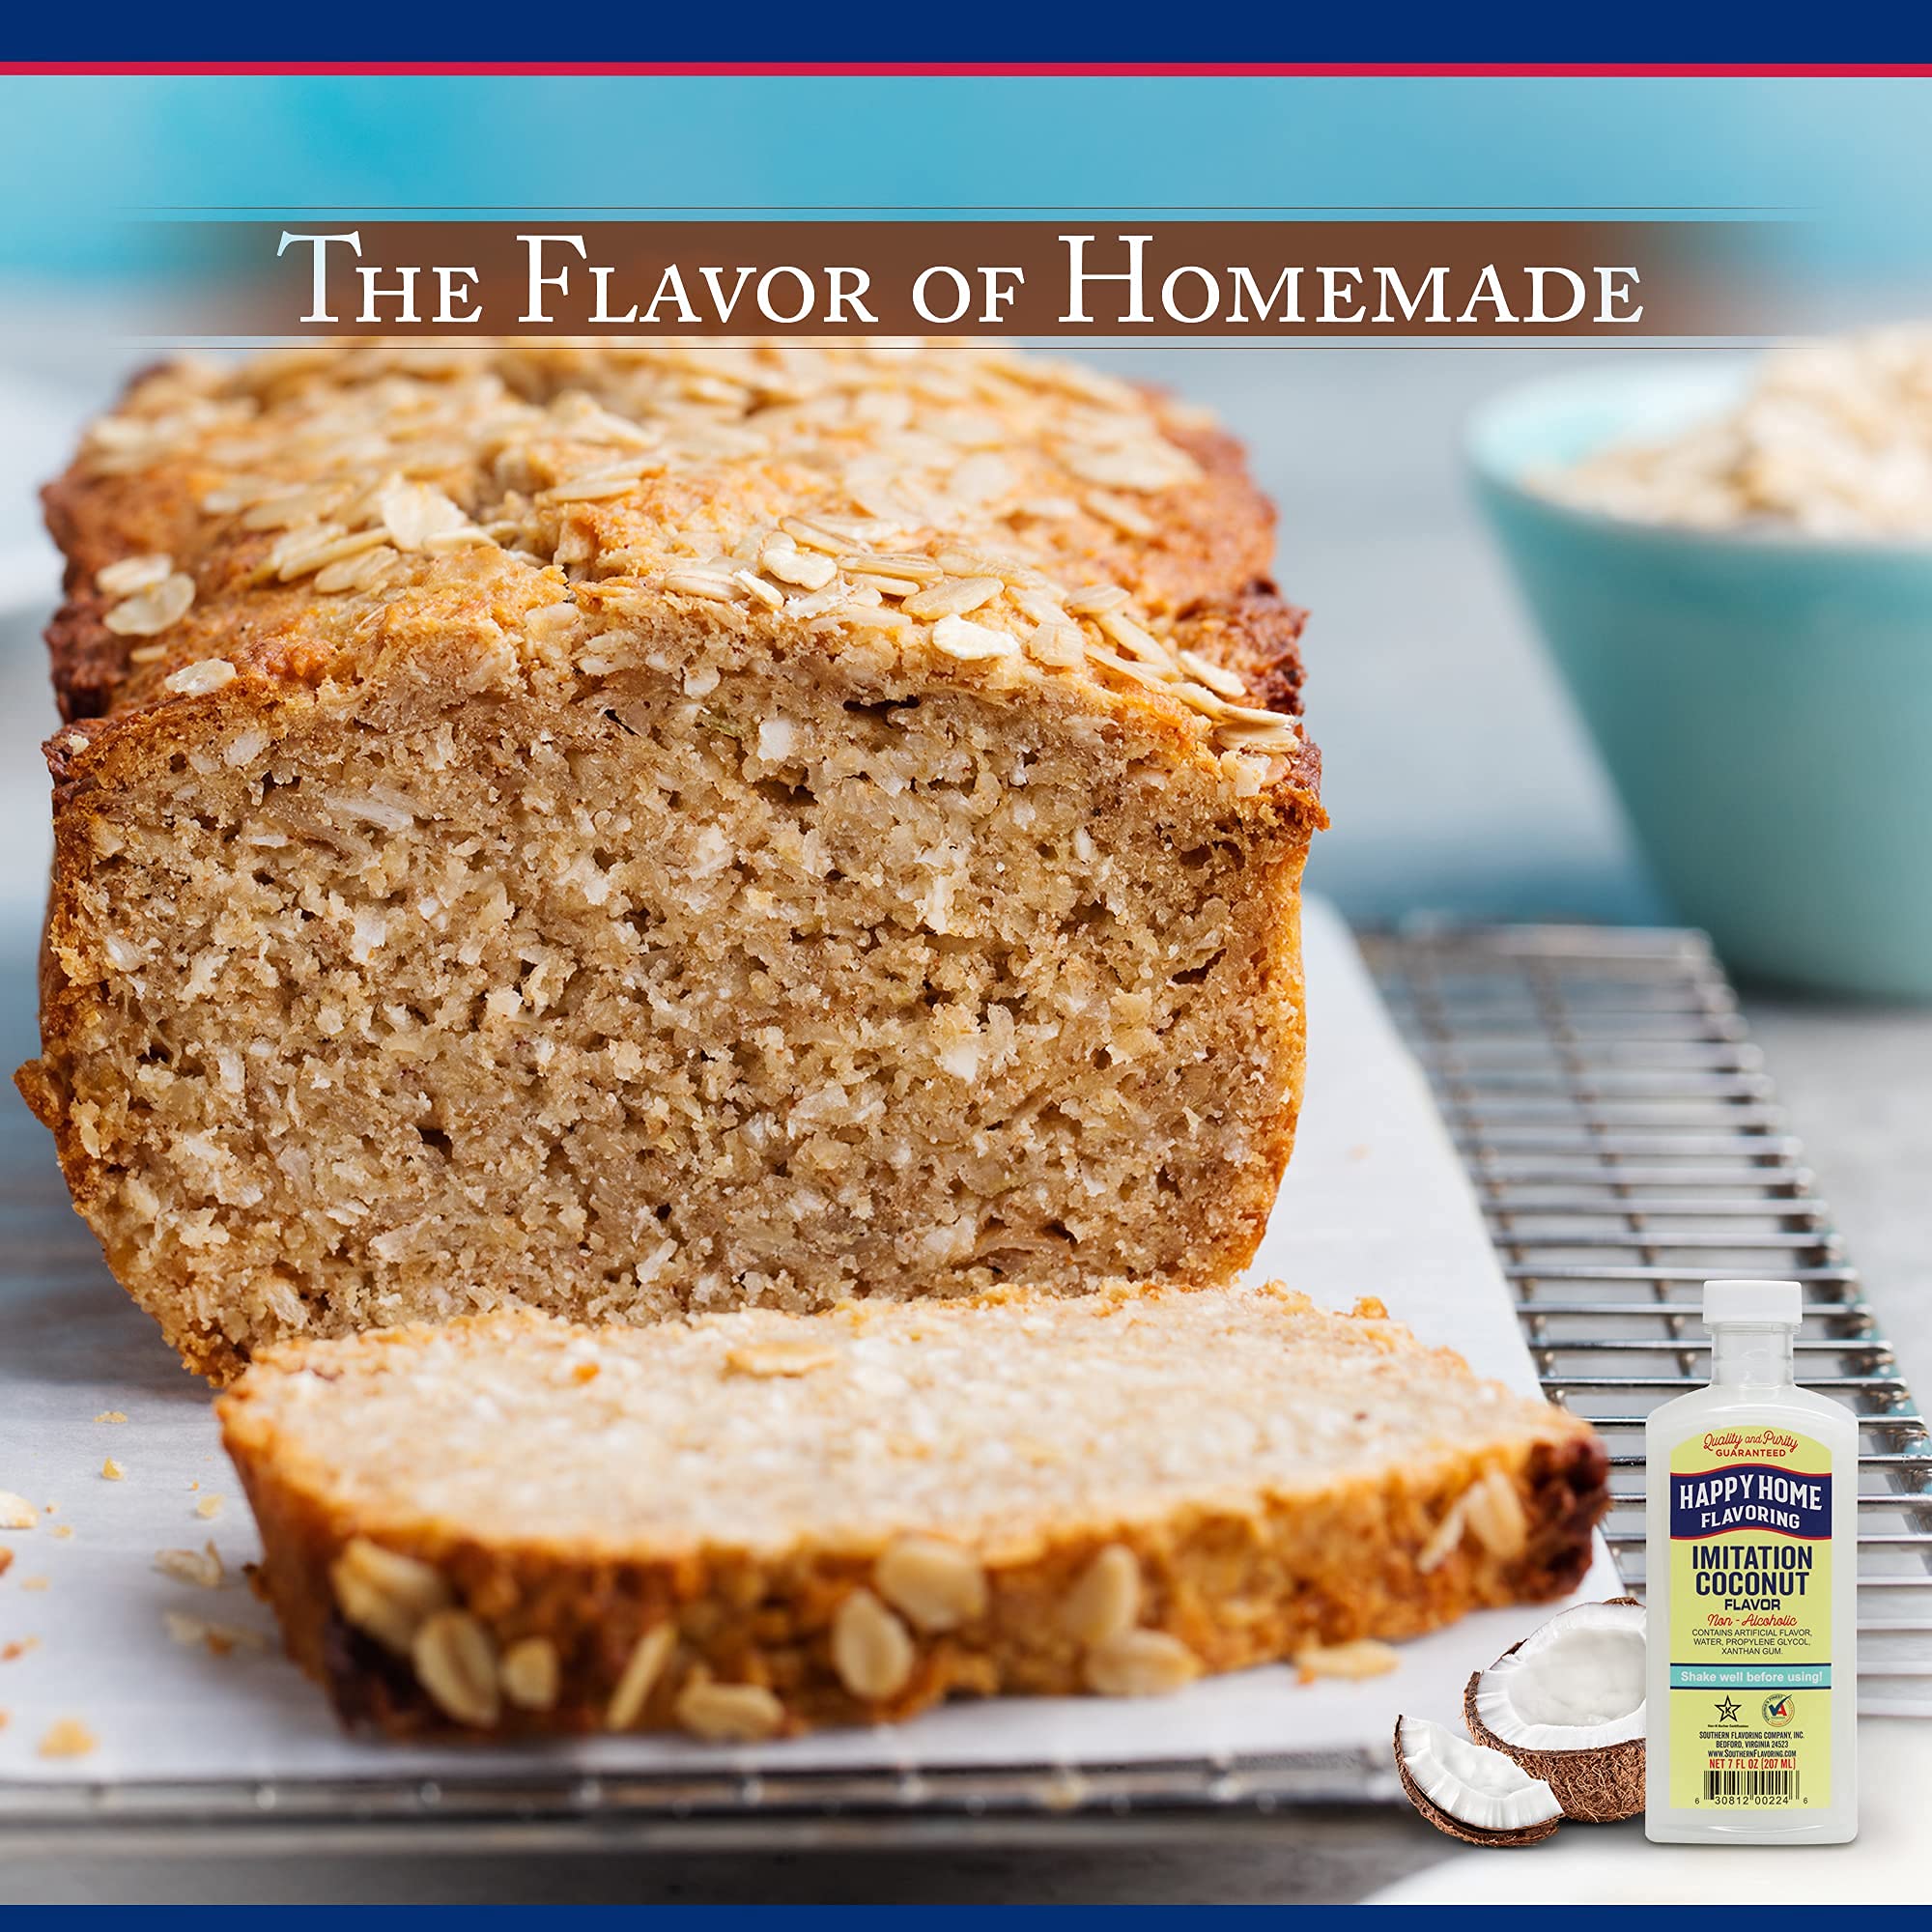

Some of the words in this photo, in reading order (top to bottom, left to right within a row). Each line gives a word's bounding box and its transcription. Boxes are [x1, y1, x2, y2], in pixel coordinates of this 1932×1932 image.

[1703, 1433, 1743, 1451] Quality
[1745, 1435, 1762, 1444] and
[1762, 1430, 1798, 1453] Purity
[1716, 1449, 1786, 1458] GUARANTEED
[1680, 1474, 1754, 1509] HAPPY
[1758, 1475, 1823, 1511] HOME
[1701, 1505, 1801, 1529] FLAVORING
[1692, 1546, 1812, 1570] IMITATION
[1695, 1571, 1810, 1595] COCONUT
[1724, 1599, 1781, 1610] FLAVOR
[1742, 1613, 1798, 1627] Alcoholic
[1779, 1629, 1812, 1637] FLAVOR,
[1681, 1671, 1717, 1682] Shake
[1719, 1671, 1744, 1682] well
[1747, 1671, 1784, 1682] before
[1787, 1671, 1823, 1684] using!
[1698, 1731, 1729, 1740] SOUTHERN
[1731, 1731, 1763, 1740] FLAVORING
[1763, 1731, 1792, 1741] COMPANY,
[1709, 1759, 1725, 1769] NET
[1728, 1759, 1733, 1769] 7
[1735, 1759, 1746, 1769] FL
[1747, 1759, 1759, 1769] OZ
